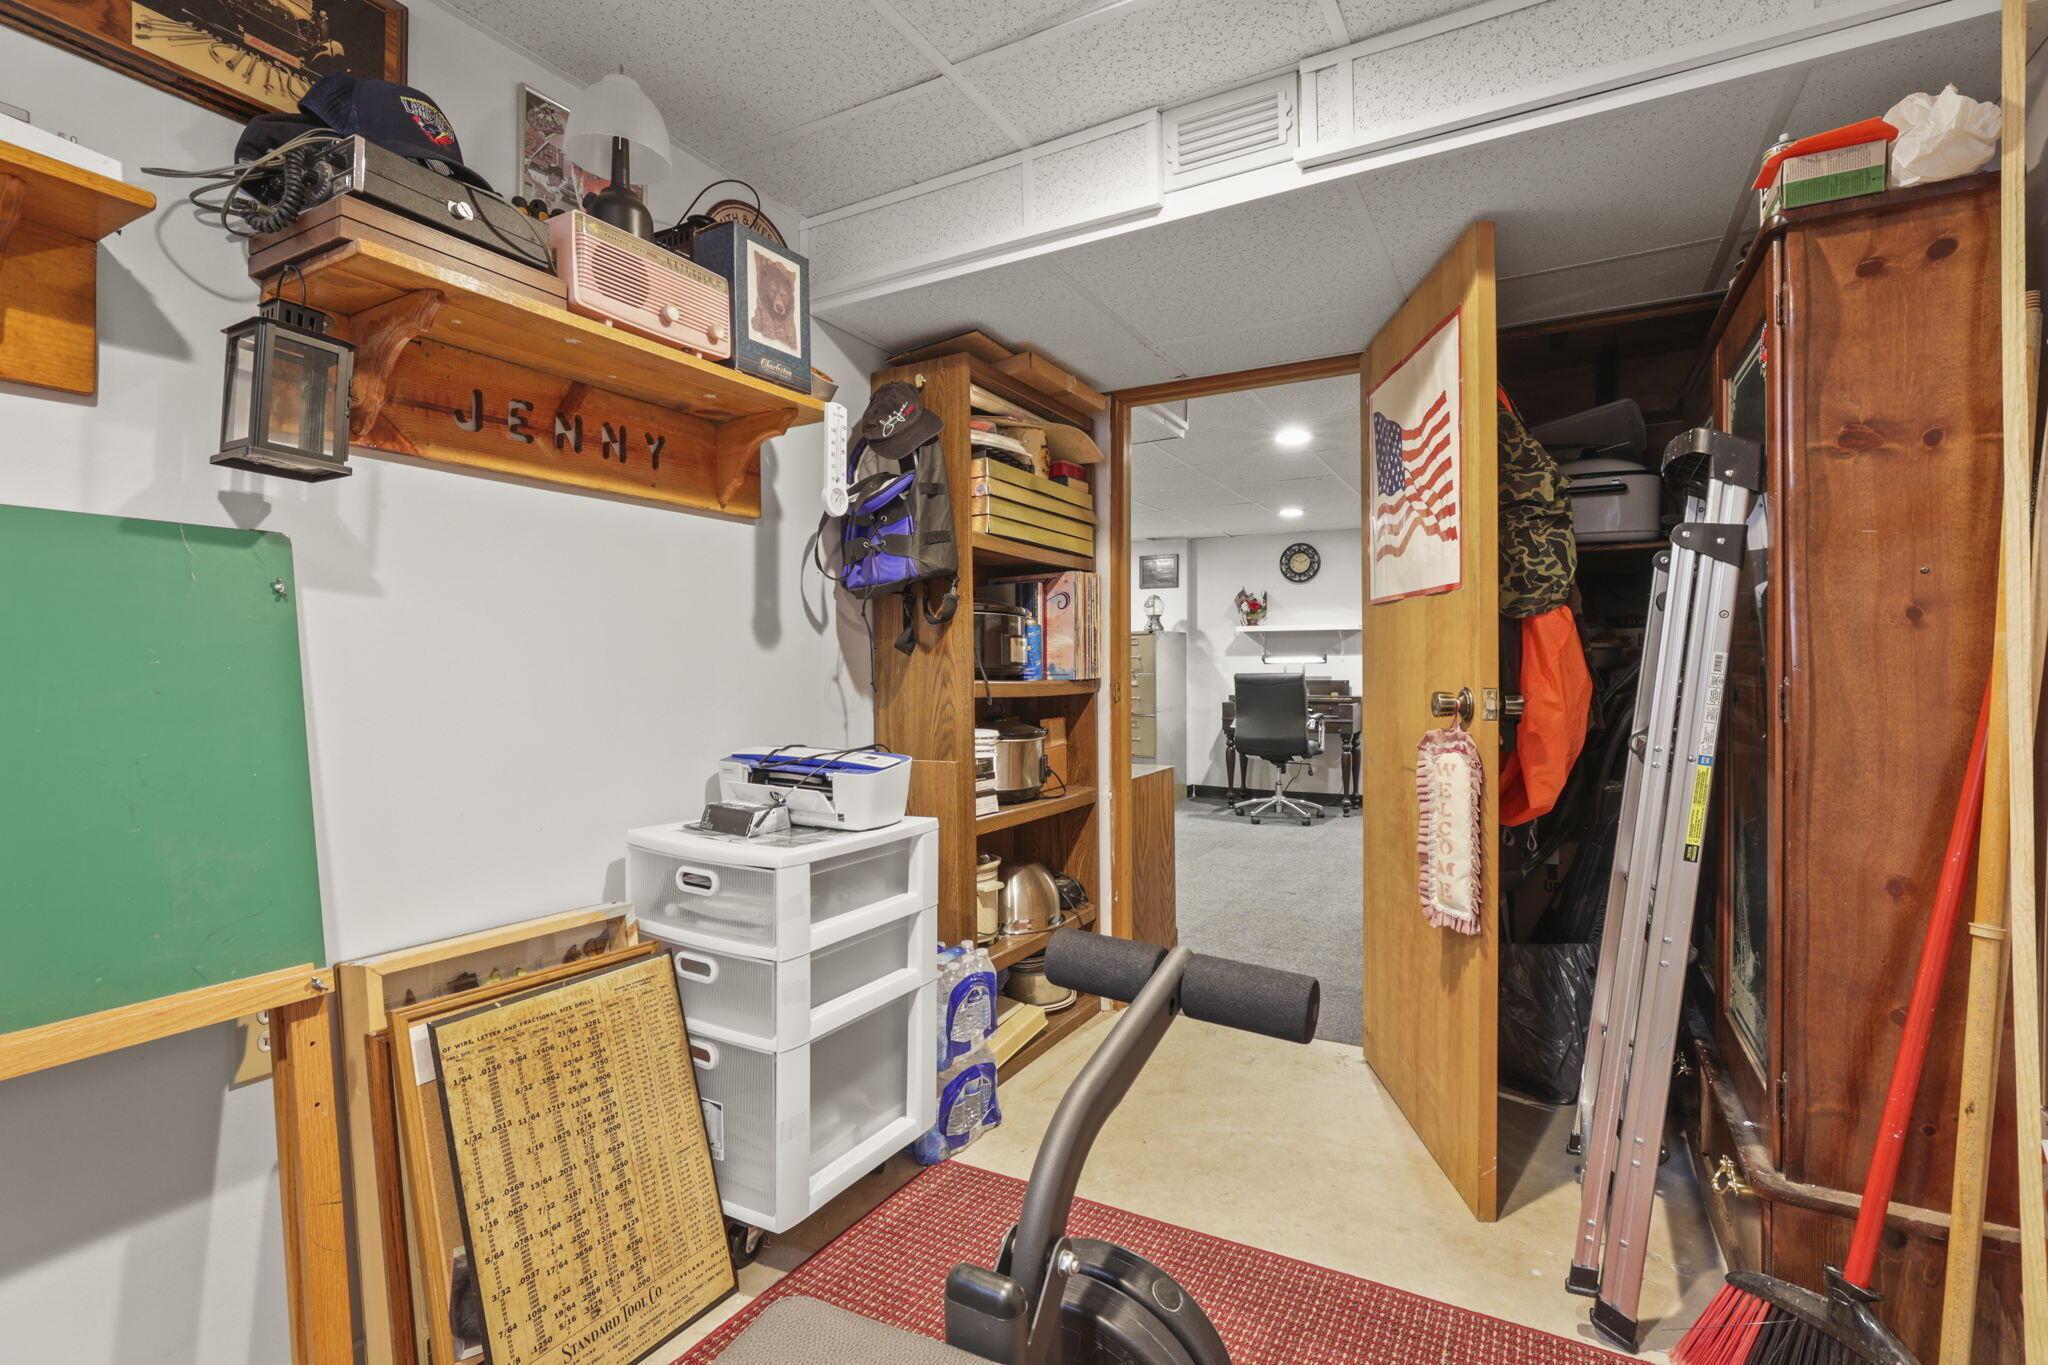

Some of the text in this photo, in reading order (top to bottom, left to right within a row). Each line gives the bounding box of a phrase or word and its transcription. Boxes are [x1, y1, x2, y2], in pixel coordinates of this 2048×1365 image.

[454, 388, 666, 470] JENNY
[1435, 762, 1457, 899] WELCOME
[476, 1029, 500, 1041] LETTER
[504, 1024, 516, 1032] AND
[519, 1010, 557, 1027] FRACTIONAL
[574, 998, 594, 1008] DRILLS
[557, 1018, 600, 1038] 21/64 .3281
[509, 1044, 554, 1065] 9/64 .1406
[560, 1032, 604, 1052] 11/32 .3437
[562, 1055, 583, 1067] 23/64
[569, 1057, 608, 1077] 3/8 .3750
[453, 1063, 501, 1086] 1/64 .0156
[514, 1083, 533, 1095] 5/32
[518, 1112, 540, 1126] 11/64
[544, 1101, 565, 1114] .1719
[571, 1096, 591, 1109] 13/32
[576, 1111, 592, 1123] 7/16
[598, 1101, 616, 1113] .4375
[463, 1119, 512, 1146] 1/32 .0313
[575, 1122, 596, 1135] 15/32
[600, 1112, 618, 1124] .4687
[602, 1122, 621, 1135] .5000
[526, 1130, 571, 1155] 3/16 .1875
[583, 1152, 600, 1165] 9/16
[530, 1163, 577, 1190] 13/64 .2031
[589, 1172, 601, 1183] 5/8
[474, 1181, 524, 1211] 3/64 .0469
[537, 1187, 582, 1215] 7/32 .2187
[589, 1178, 631, 1204] 11/16 .6875
[479, 1202, 528, 1233] 1/16 .0625
[597, 1197, 635, 1222] 3/4 .7500
[539, 1208, 586, 1237] 15/64 .2344
[484, 1249, 504, 1266] 5/64
[512, 1233, 533, 1249] .0781
[550, 1228, 590, 1256] 1/4 .2500
[596, 1229, 617, 1245] 13/16
[546, 1259, 568, 1276] 17/64
[605, 1251, 616, 1263] 7/8
[491, 1286, 511, 1303] 3/32
[517, 1268, 540, 1286] .0937
[553, 1270, 597, 1302] 9/32 .2812
[604, 1270, 624, 1287] 15/16
[632, 1276, 650, 1292] 1.000
[554, 1286, 600, 1320] 19/64 .2968
[558, 1298, 602, 1331] 5/16 .3125
[561, 1312, 621, 1364] STANDARD
[620, 1293, 648, 1324] TOOL
[710, 1244, 726, 1258] OHIO
[498, 1304, 547, 1340] 7/64 .1093
[530, 1335, 552, 1354] .1250
